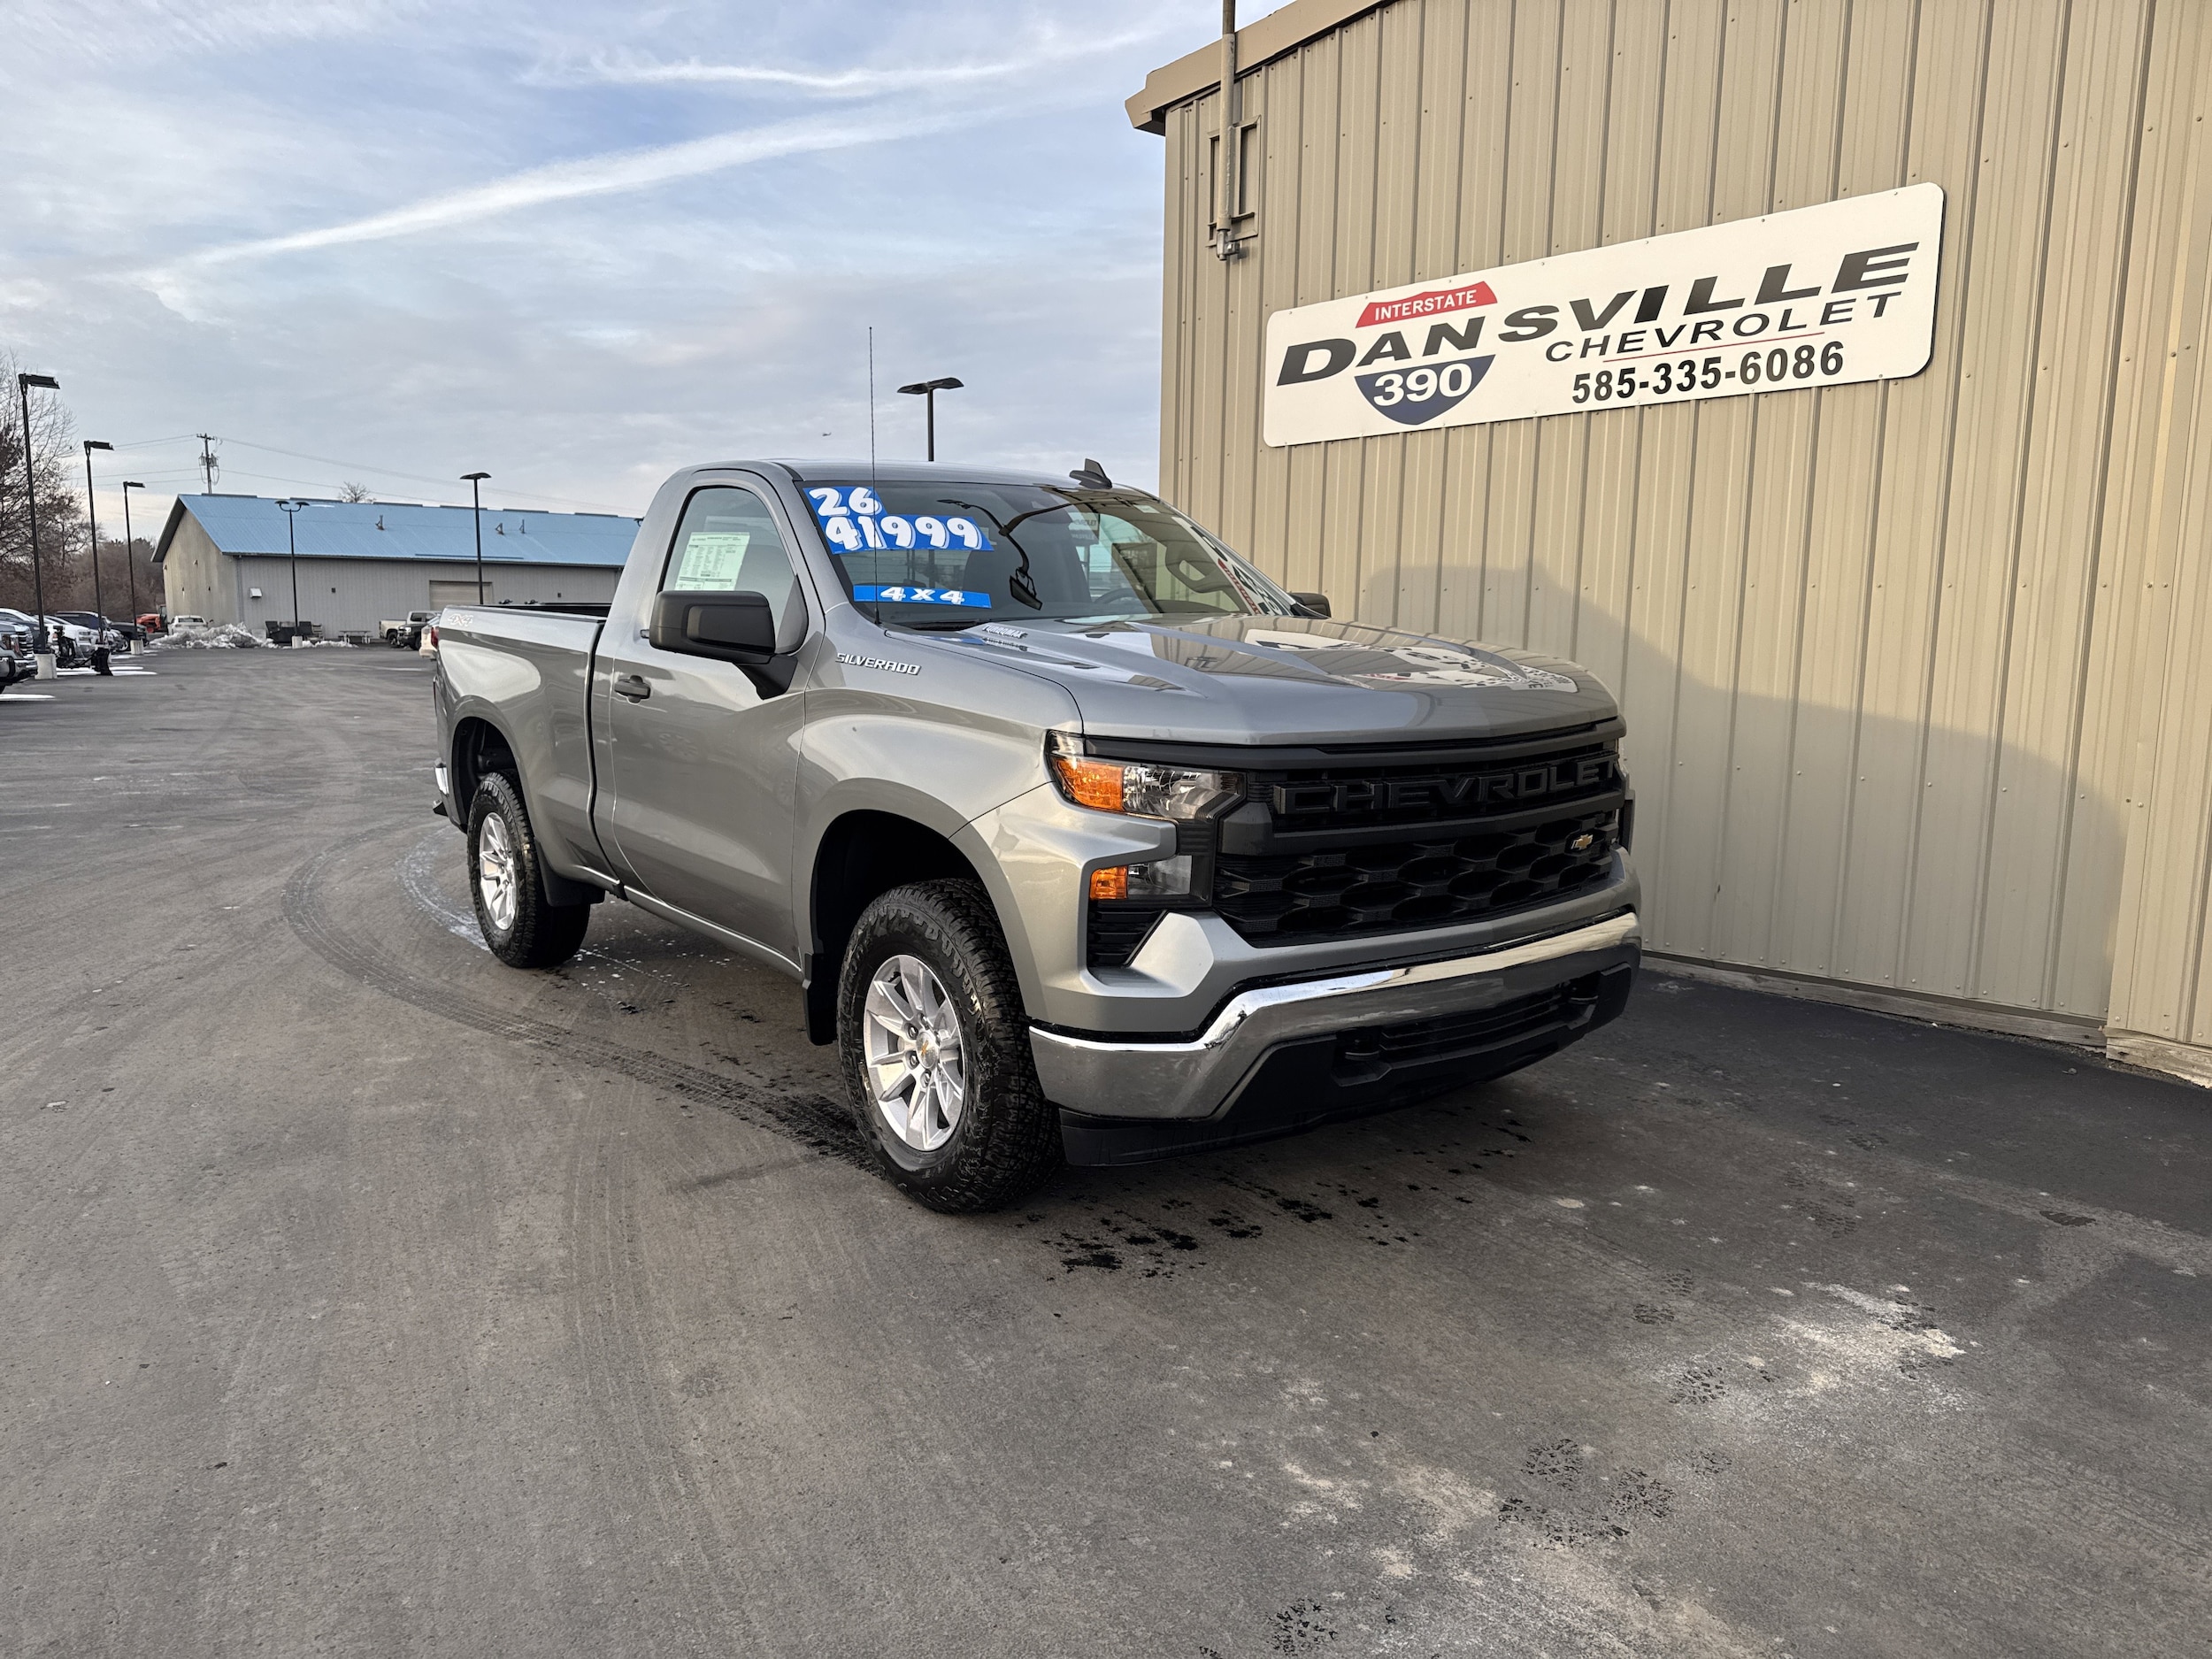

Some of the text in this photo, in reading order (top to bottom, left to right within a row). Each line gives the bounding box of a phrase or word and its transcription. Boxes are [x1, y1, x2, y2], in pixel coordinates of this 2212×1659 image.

[1374, 288, 1477, 321] INTERSTATE
[1545, 291, 1901, 363] CHEVROLET
[1372, 362, 1472, 408] 390
[1571, 341, 1845, 403] 585-335-6086
[809, 487, 882, 517] 26
[825, 516, 981, 550] 41999
[835, 652, 921, 676] SILVERADO
[1273, 754, 1617, 815] CHEVROLET
